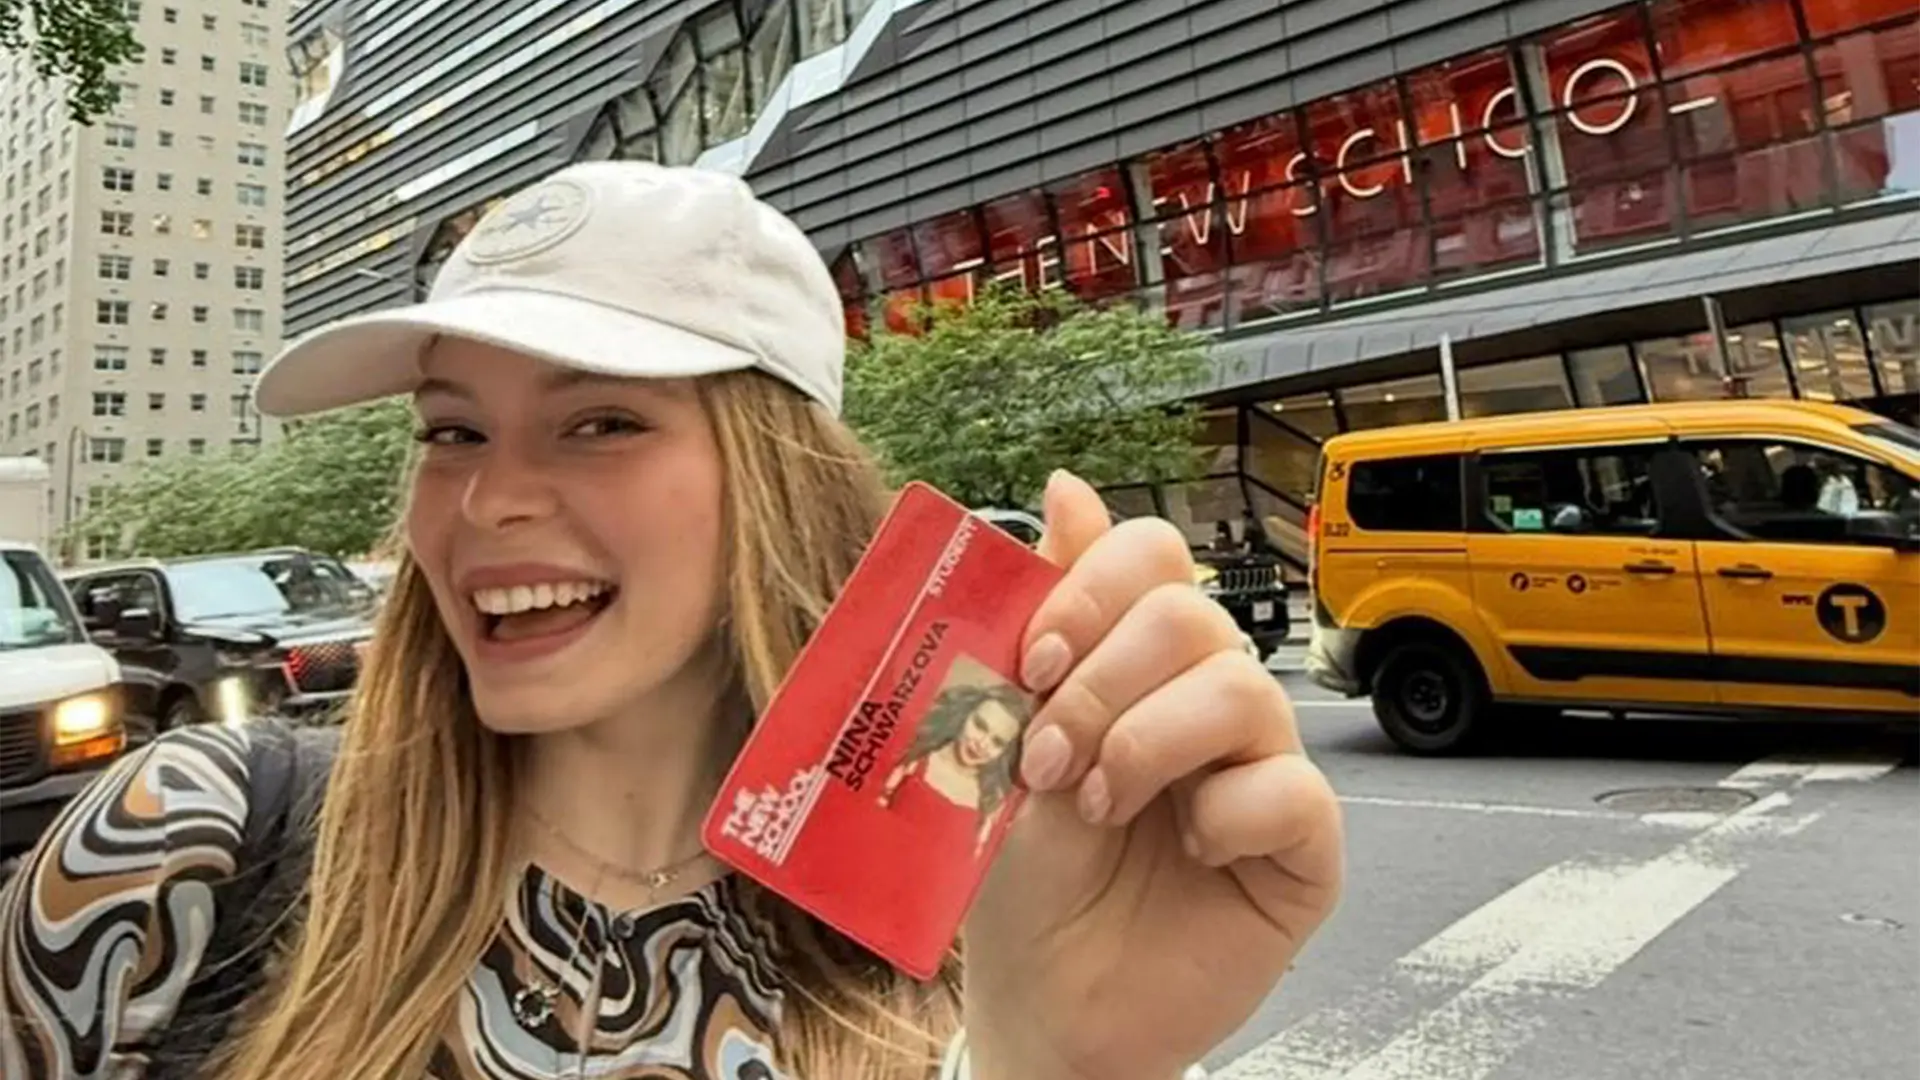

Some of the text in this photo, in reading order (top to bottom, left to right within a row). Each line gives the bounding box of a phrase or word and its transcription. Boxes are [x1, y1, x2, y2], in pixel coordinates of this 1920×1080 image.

[952, 235, 1064, 306] THE
[1085, 169, 1250, 276] NEW
[927, 517, 980, 598] STUDENT
[1830, 594, 1868, 635] T
[825, 700, 884, 780] NINA
[844, 620, 950, 793] SCHWARZOVA
[721, 786, 757, 838] THE
[741, 783, 781, 849] NEW
[756, 764, 820, 861] SCHOOL
